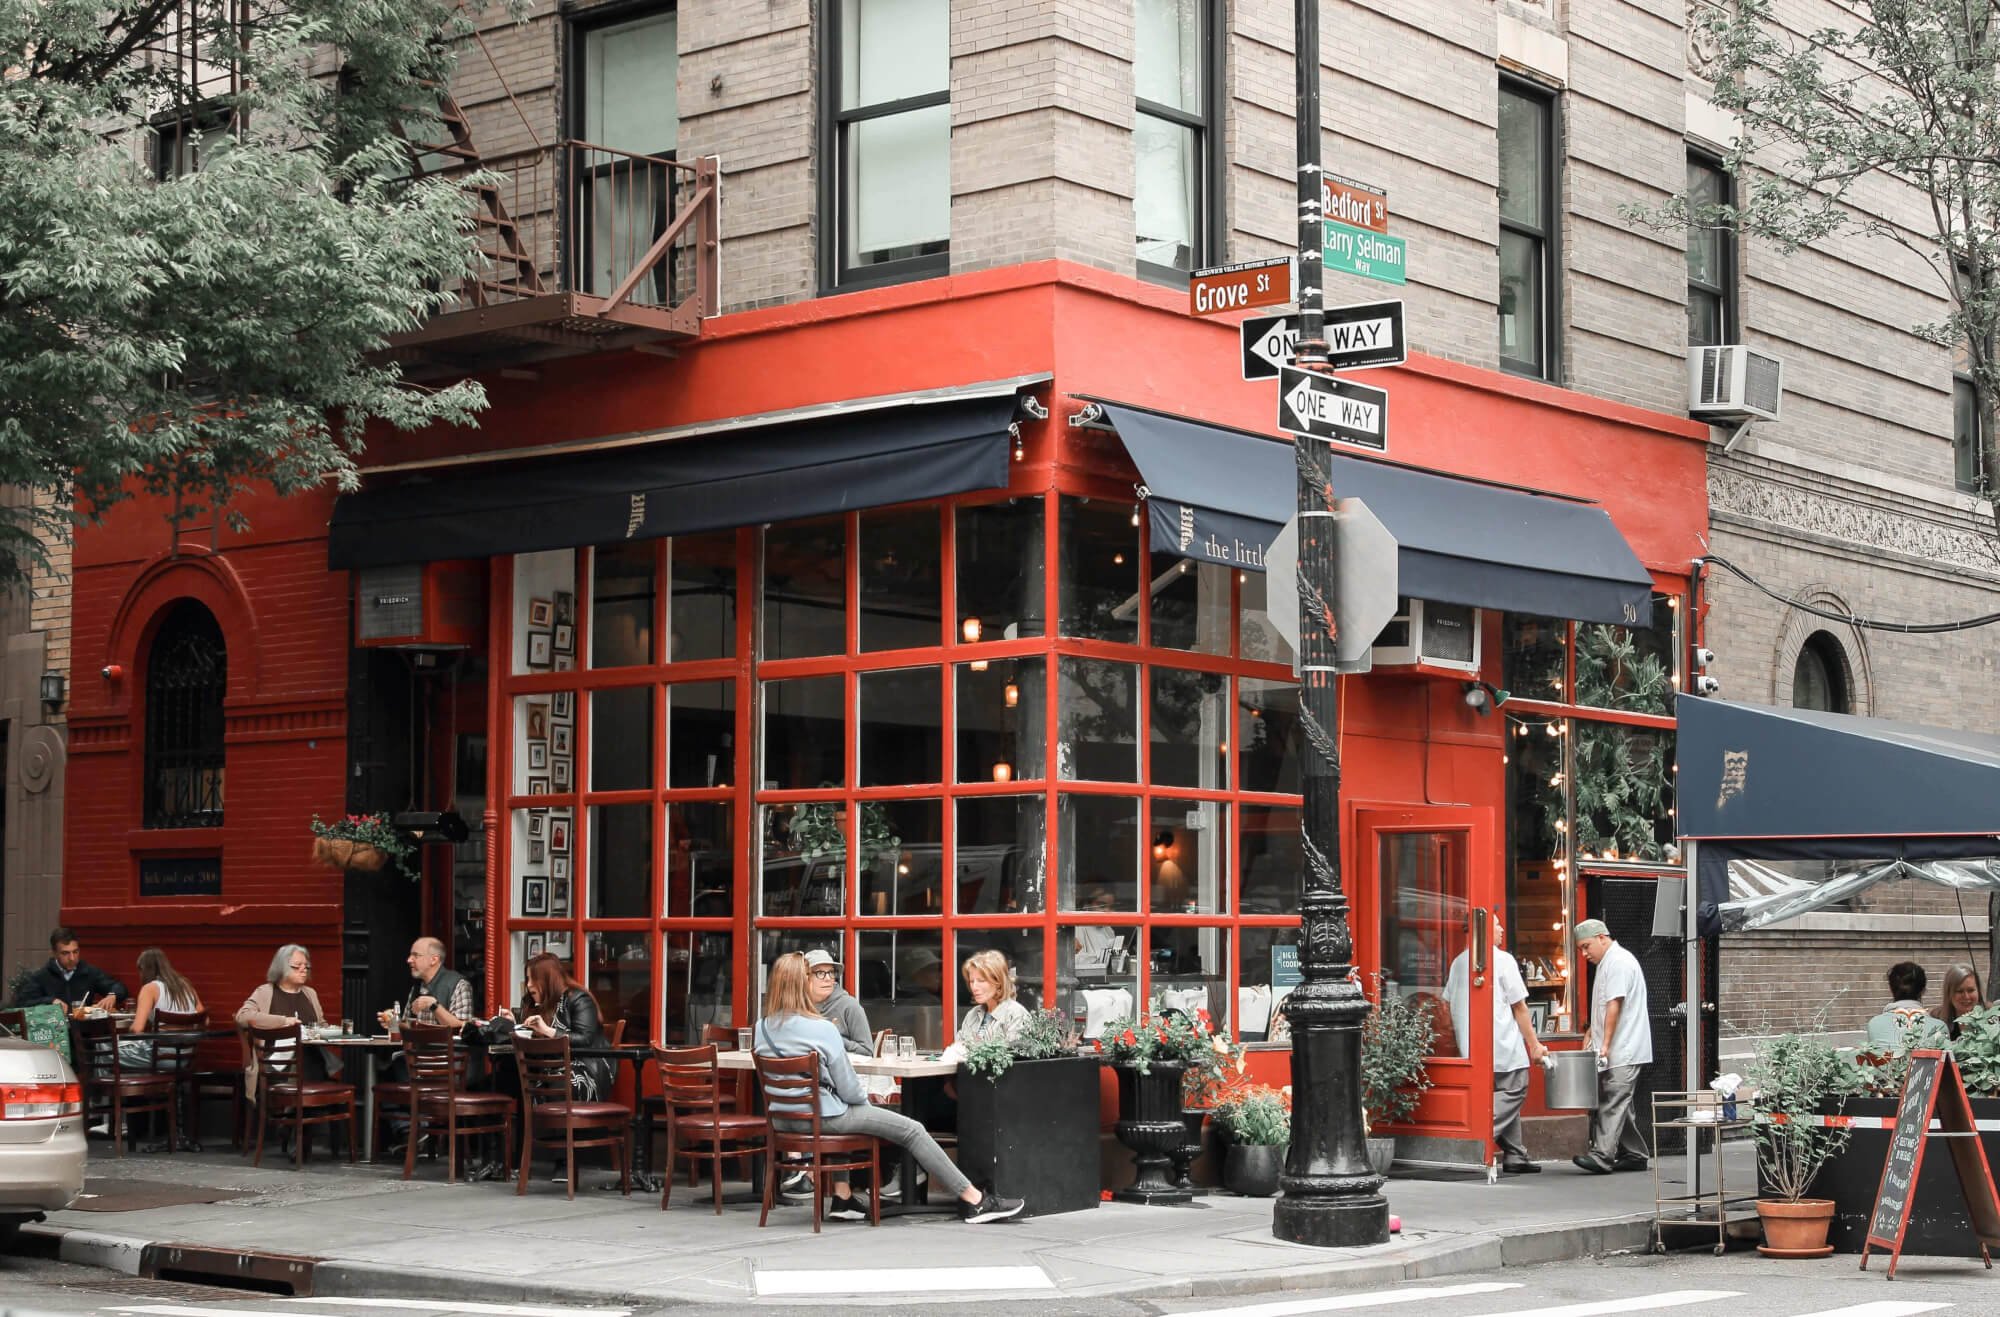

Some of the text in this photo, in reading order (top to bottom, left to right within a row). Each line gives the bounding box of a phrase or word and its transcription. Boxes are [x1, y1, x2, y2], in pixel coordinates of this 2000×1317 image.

[1323, 185, 1384, 226] Bedford St
[1324, 225, 1401, 265] Larry Selman
[1355, 258, 1371, 275] Way
[1196, 273, 1270, 312] Grove St
[1268, 323, 1381, 357] ON WAY
[1297, 390, 1373, 429] ONE WAY
[1205, 533, 1229, 560] the
[1623, 603, 1637, 624] 90
[1282, 951, 1292, 960] BIG
